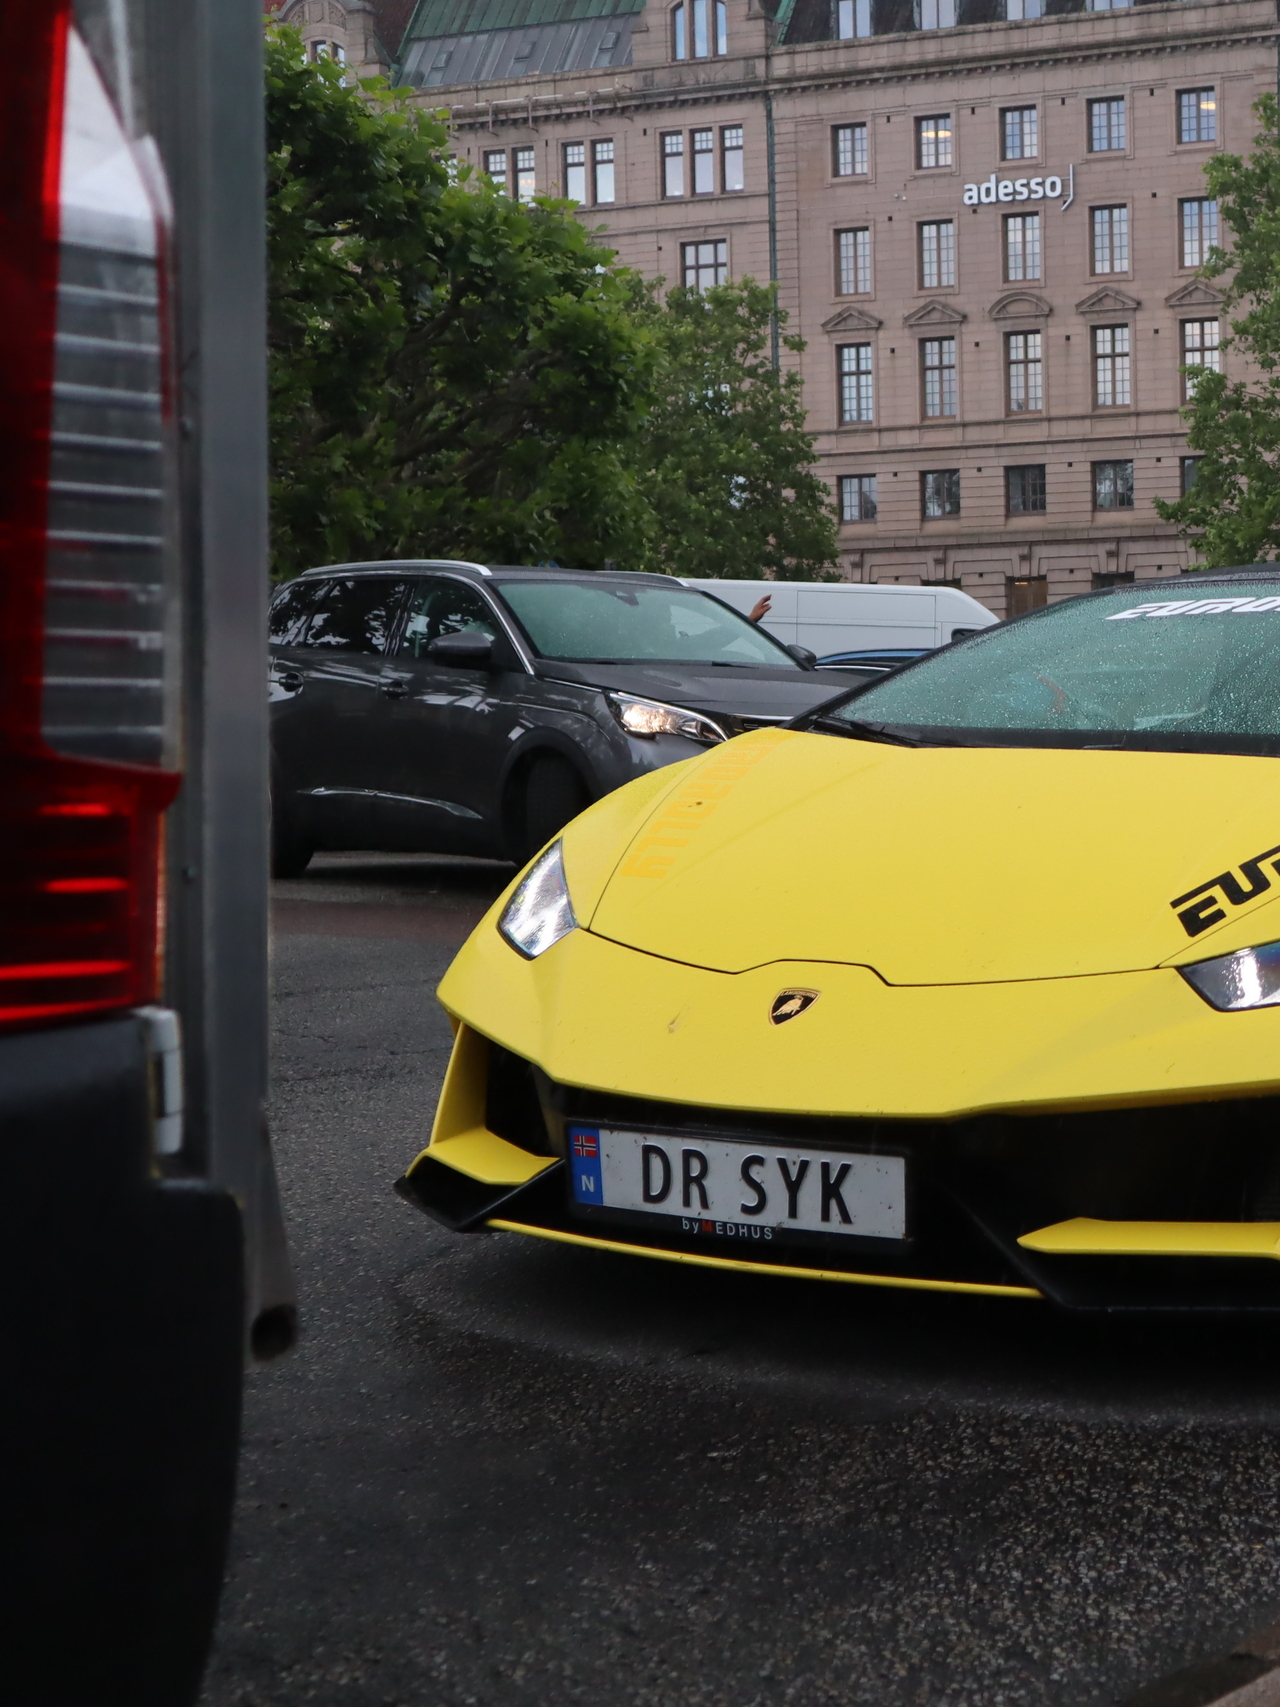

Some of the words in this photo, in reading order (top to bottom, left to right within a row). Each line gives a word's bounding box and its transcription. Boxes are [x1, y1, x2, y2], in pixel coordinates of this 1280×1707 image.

[963, 173, 1062, 205] adesso
[581, 1174, 596, 1194] N
[641, 1142, 710, 1210] DR
[739, 1153, 854, 1225] SYK
